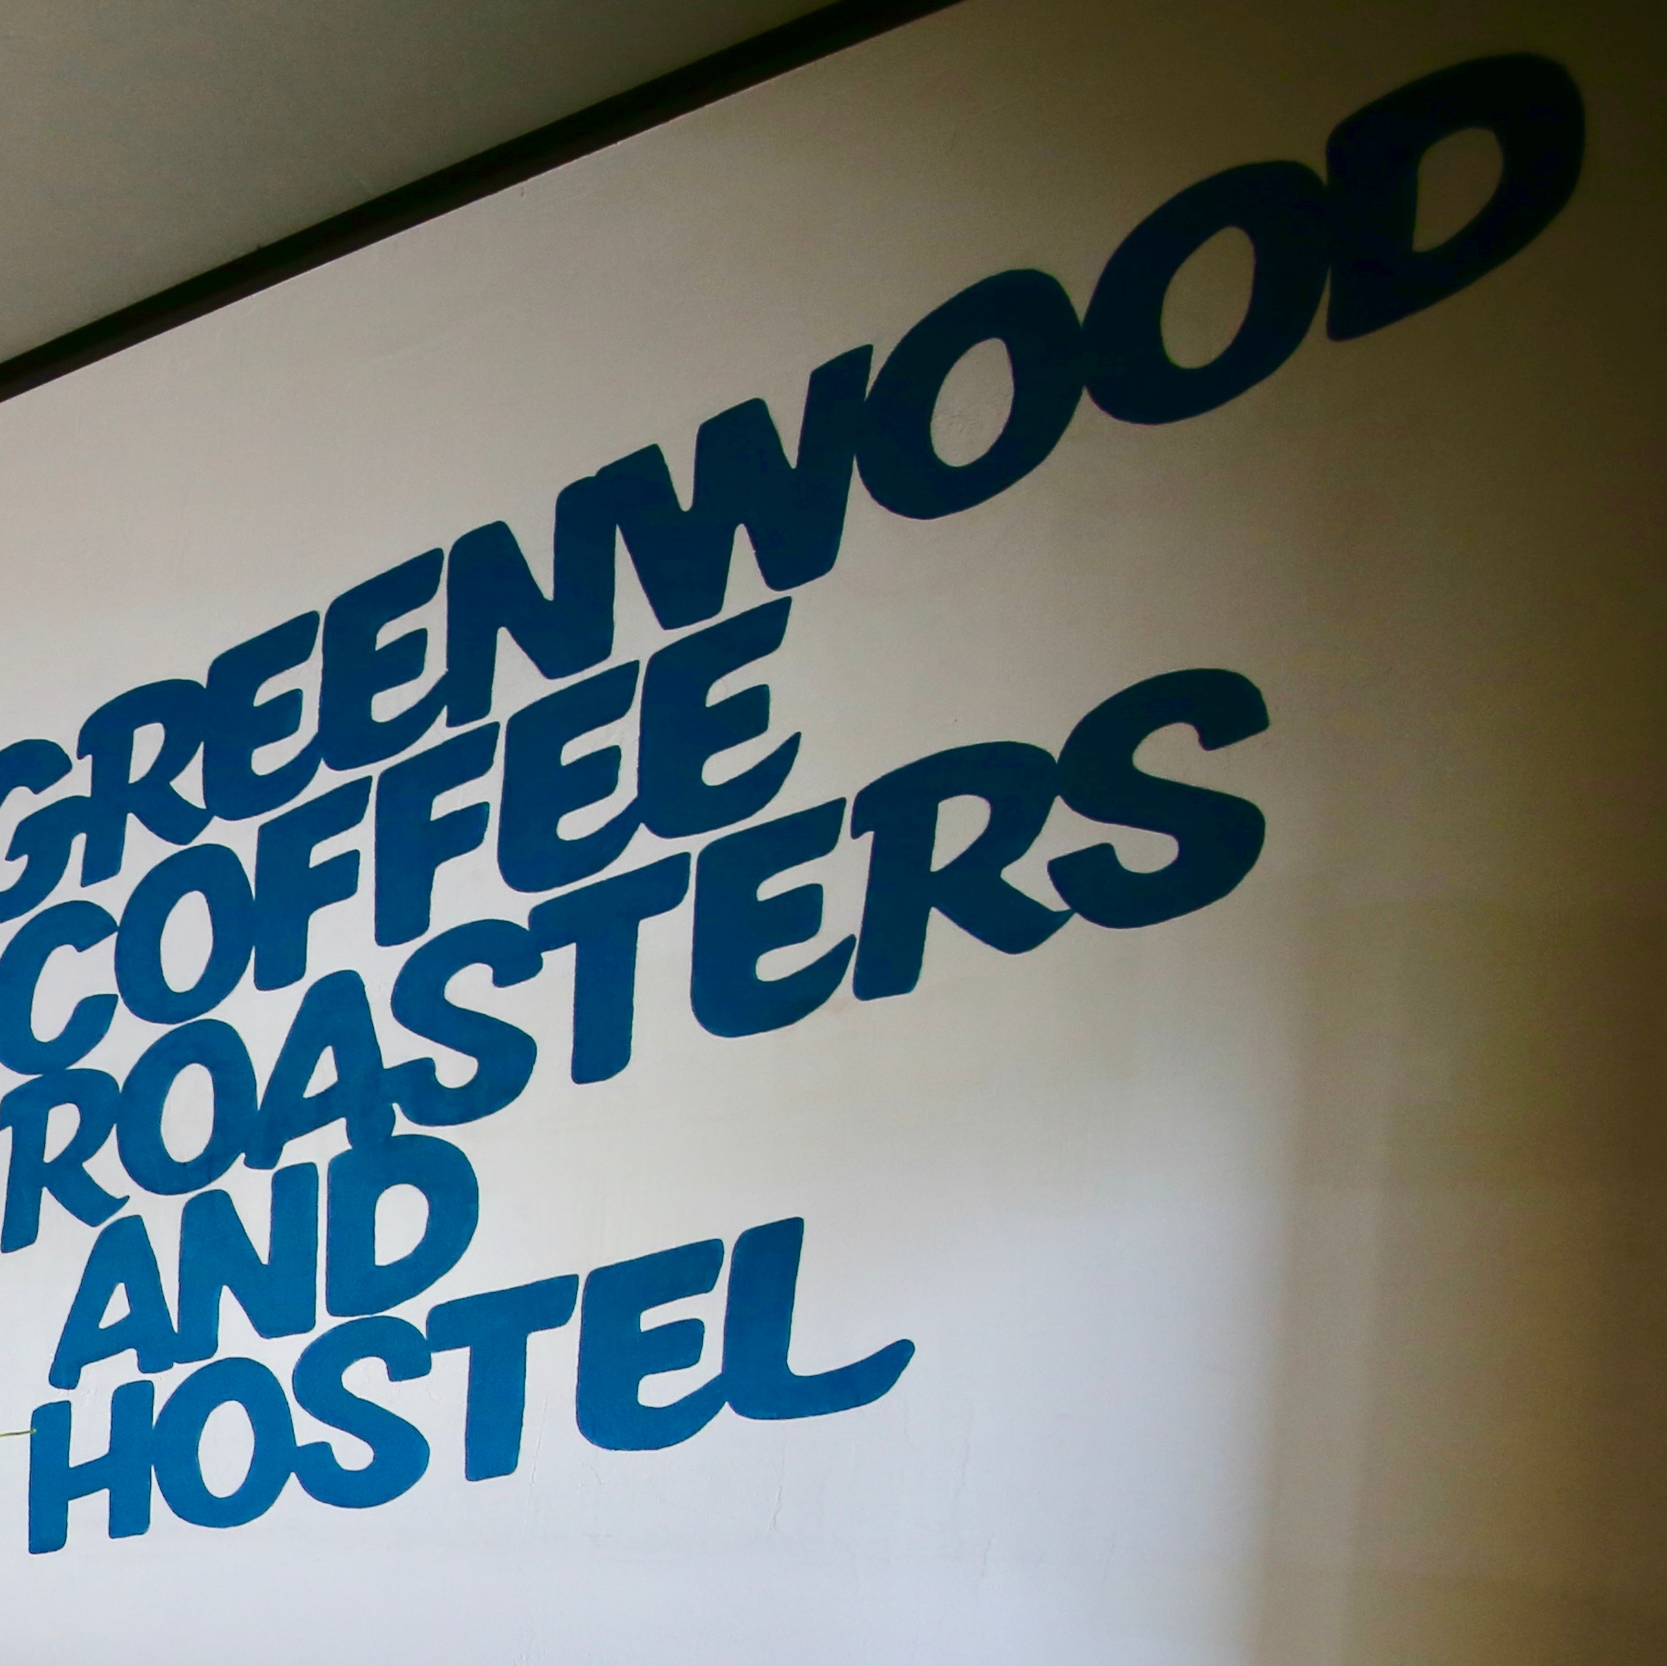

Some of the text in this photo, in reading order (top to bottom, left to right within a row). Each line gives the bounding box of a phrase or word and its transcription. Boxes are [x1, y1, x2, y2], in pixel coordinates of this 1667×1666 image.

[0, 668, 1271, 1254] ROASTERS
[27, 1215, 916, 1555] HOSTEL
[48, 1132, 480, 1392] AND
